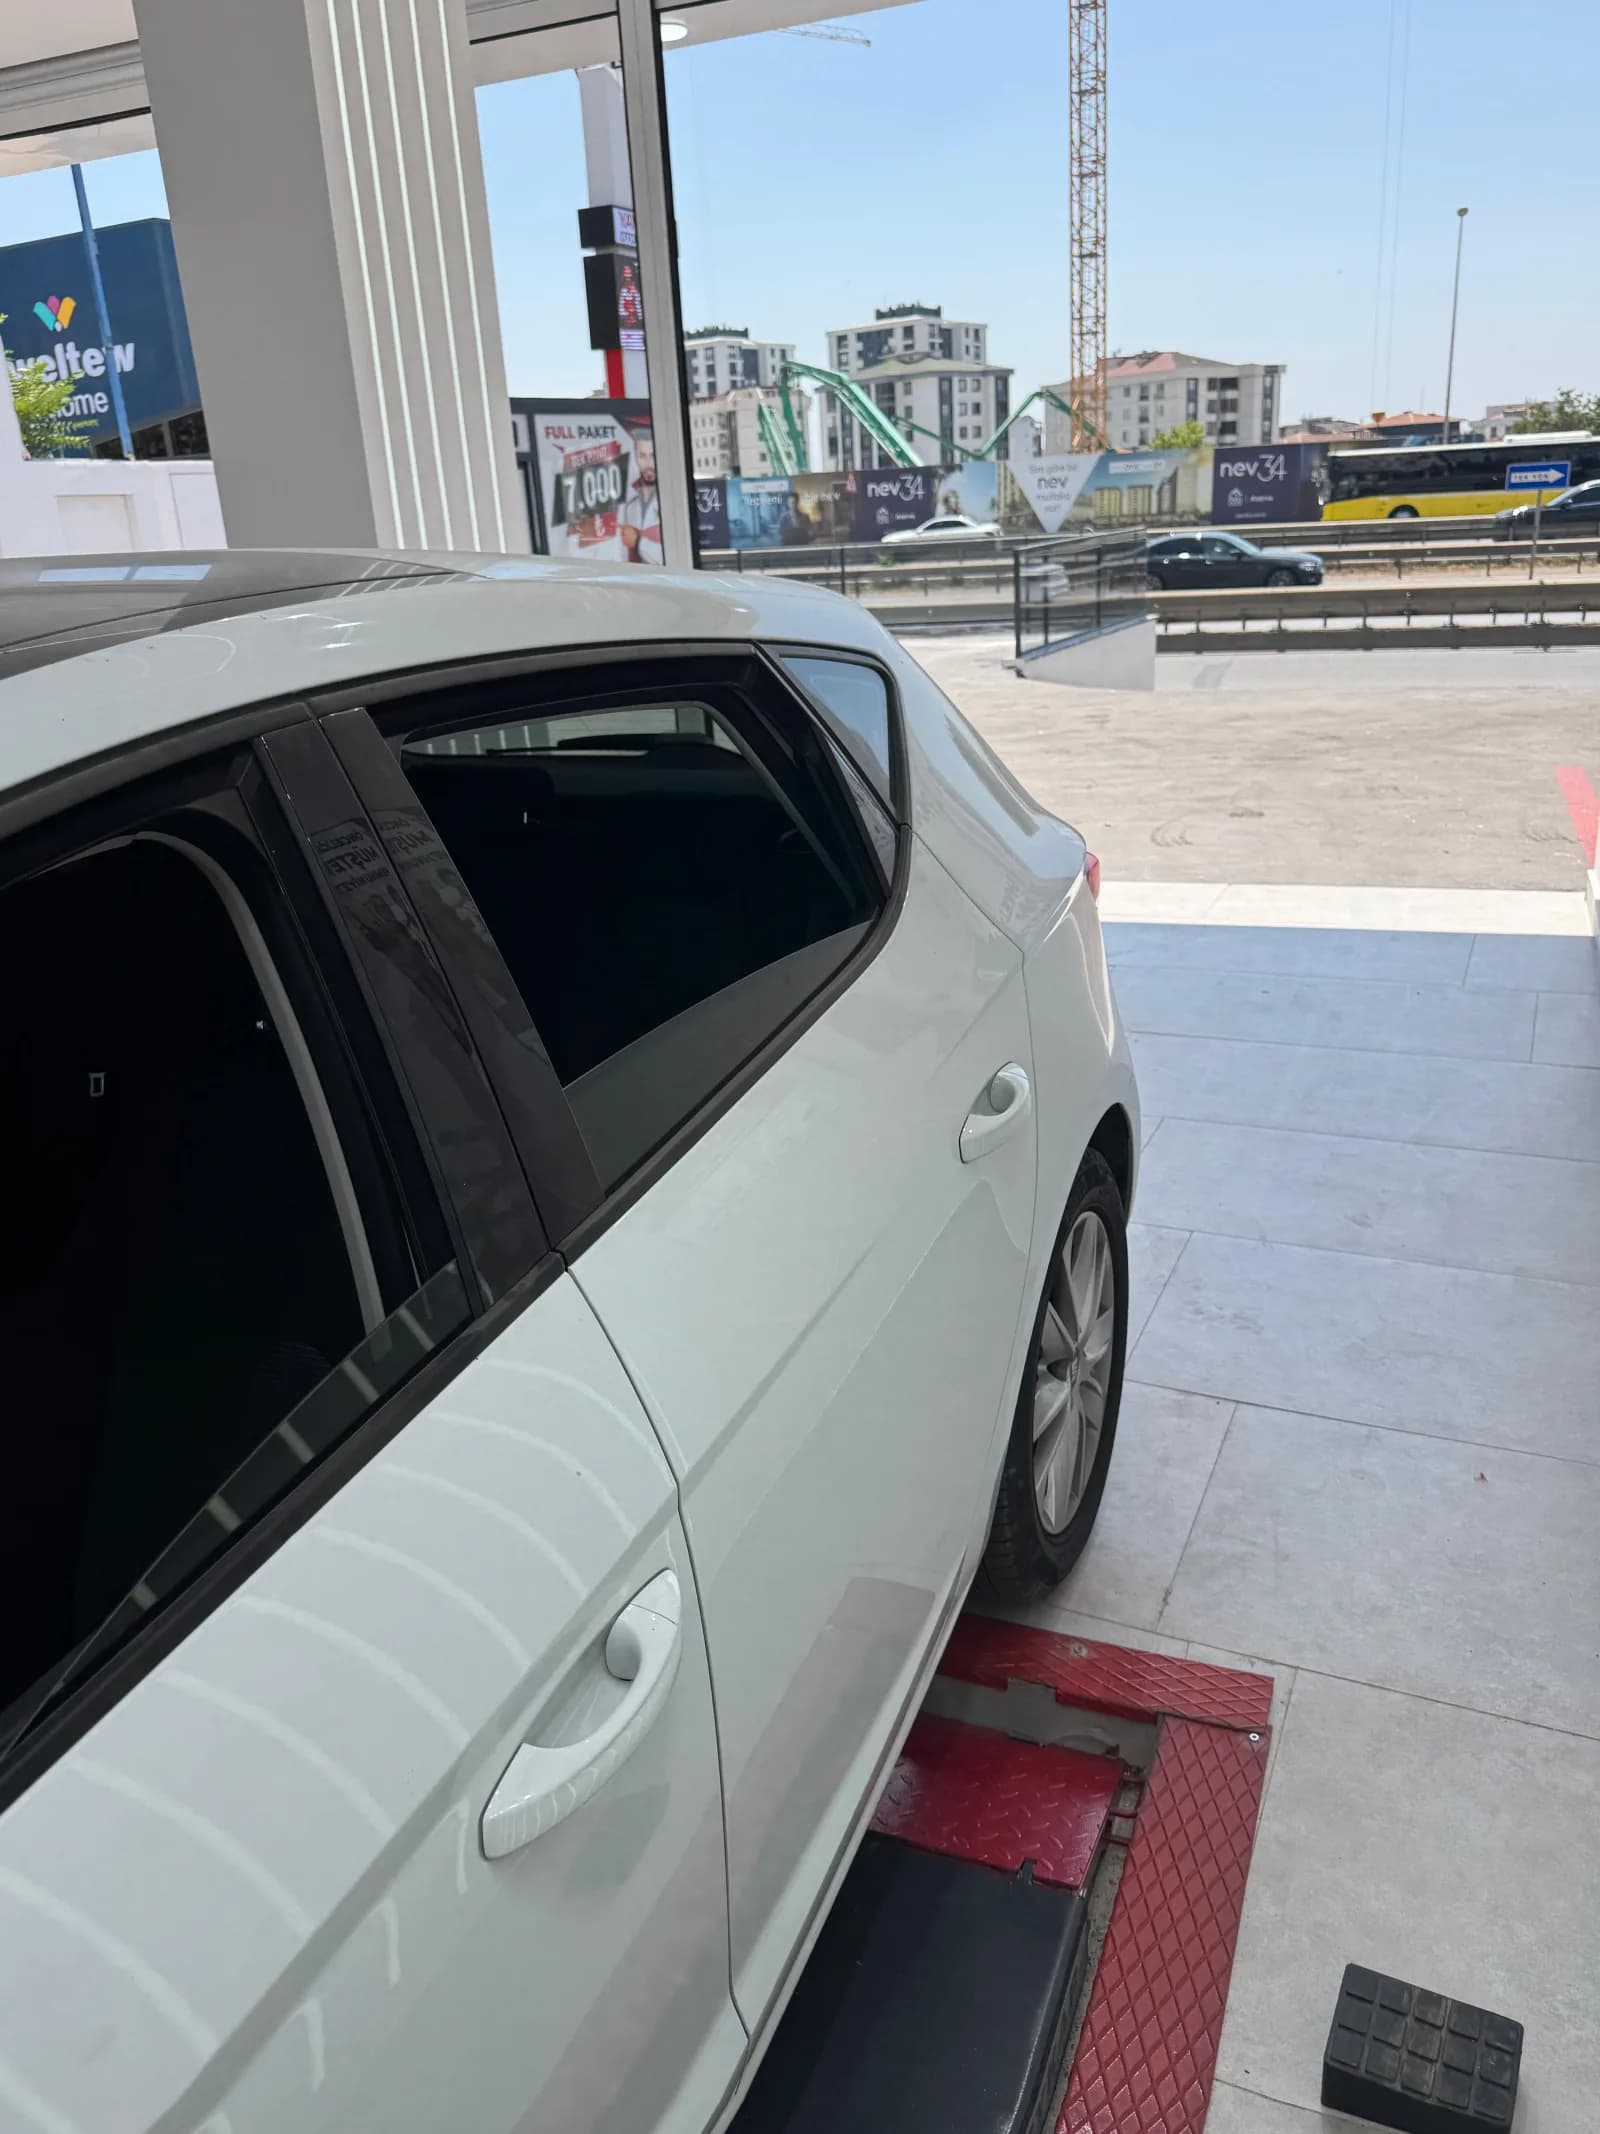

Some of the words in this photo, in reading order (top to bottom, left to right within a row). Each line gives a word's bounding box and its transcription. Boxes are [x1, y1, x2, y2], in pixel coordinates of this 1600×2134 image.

[50, 391, 109, 418] ome
[544, 426, 576, 439] FULL
[578, 425, 616, 439] PAKET
[1219, 453, 1288, 483] nev34
[561, 465, 622, 514] 7.000
[867, 473, 926, 501] nev34
[1037, 476, 1069, 489] nev
